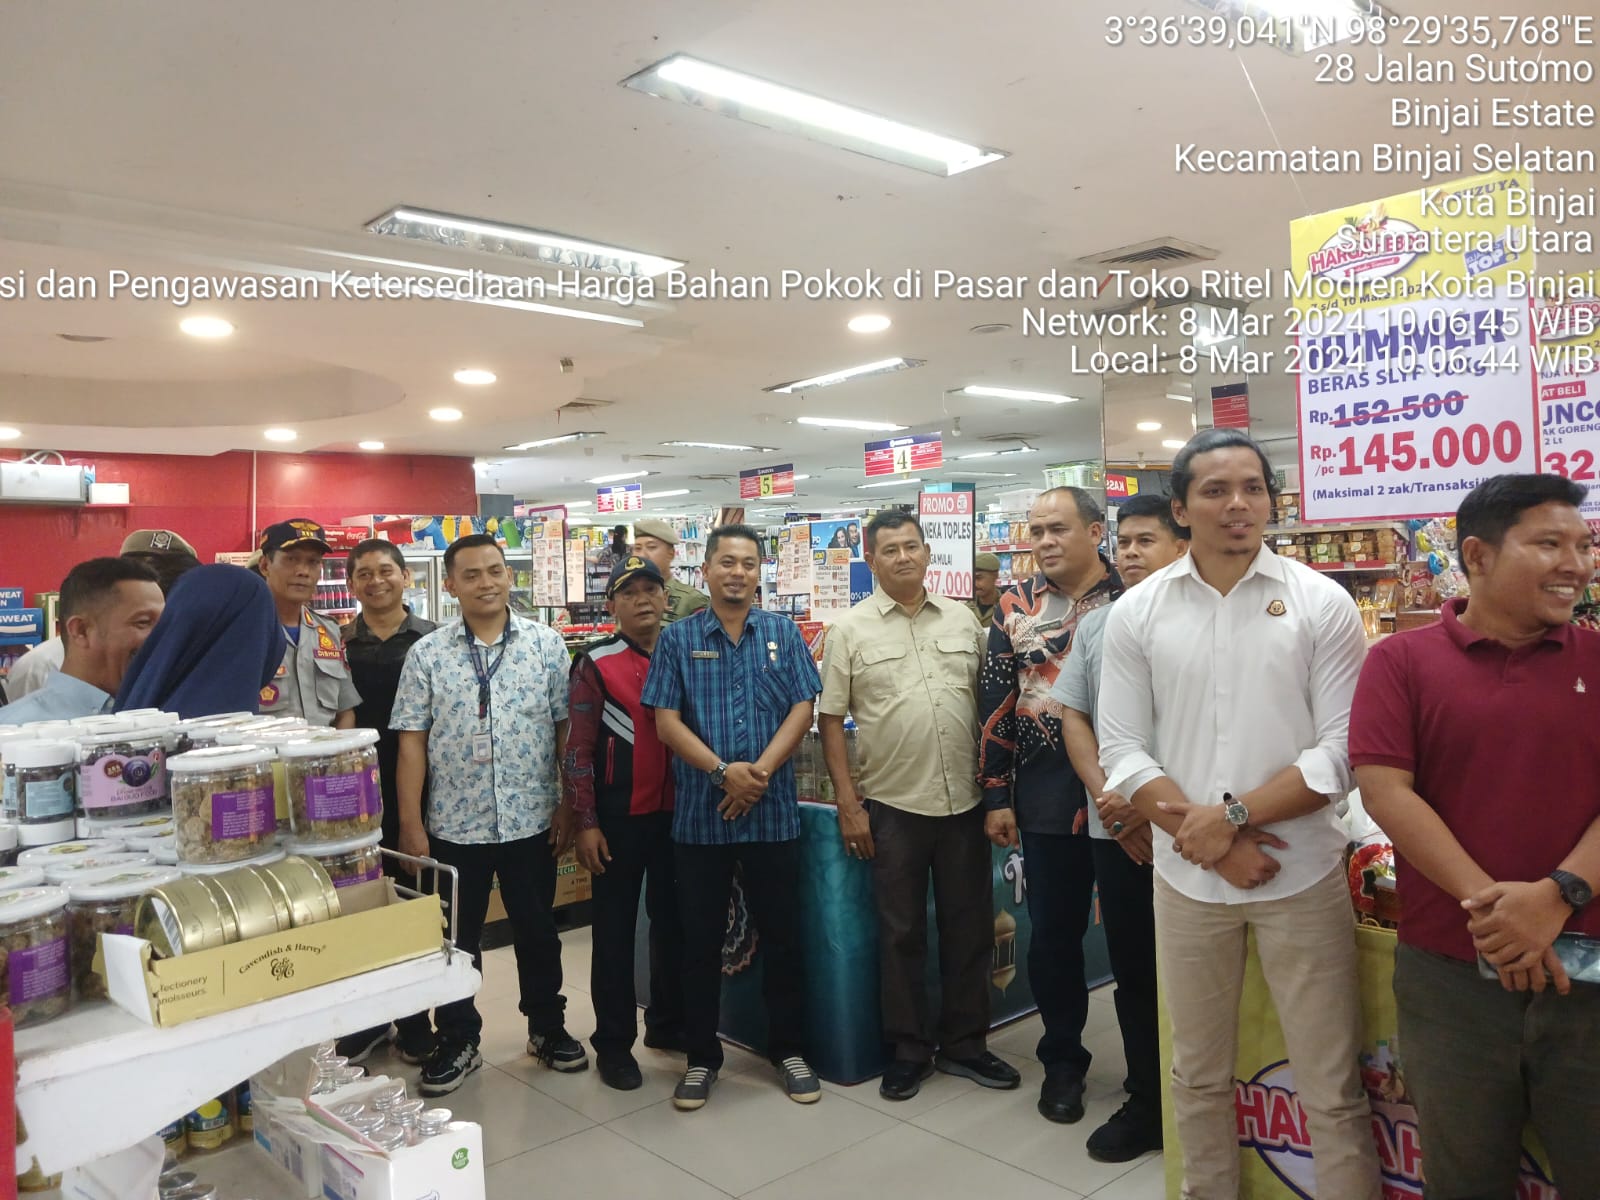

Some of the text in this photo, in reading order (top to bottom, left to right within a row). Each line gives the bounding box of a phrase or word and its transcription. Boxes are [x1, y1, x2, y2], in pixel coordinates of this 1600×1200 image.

[1308, 371, 1370, 395] BERAS
[1558, 385, 1582, 396] BELI
[1309, 390, 1464, 428] Rp. 152.500
[1310, 445, 1337, 461] Rp.
[1339, 420, 1522, 476] 145.000
[897, 449, 908, 469] 4
[1315, 464, 1335, 478] /pc
[763, 477, 770, 495] 5
[1312, 485, 1375, 501] (Maksimal
[1377, 485, 1385, 496] 2
[922, 496, 954, 513] PROMO
[943, 521, 971, 540] TOPLES
[937, 553, 953, 566] MULAI
[0, 591, 21, 599] WEAT
[238, 947, 283, 974] Cavendish
[285, 944, 292, 952] &
